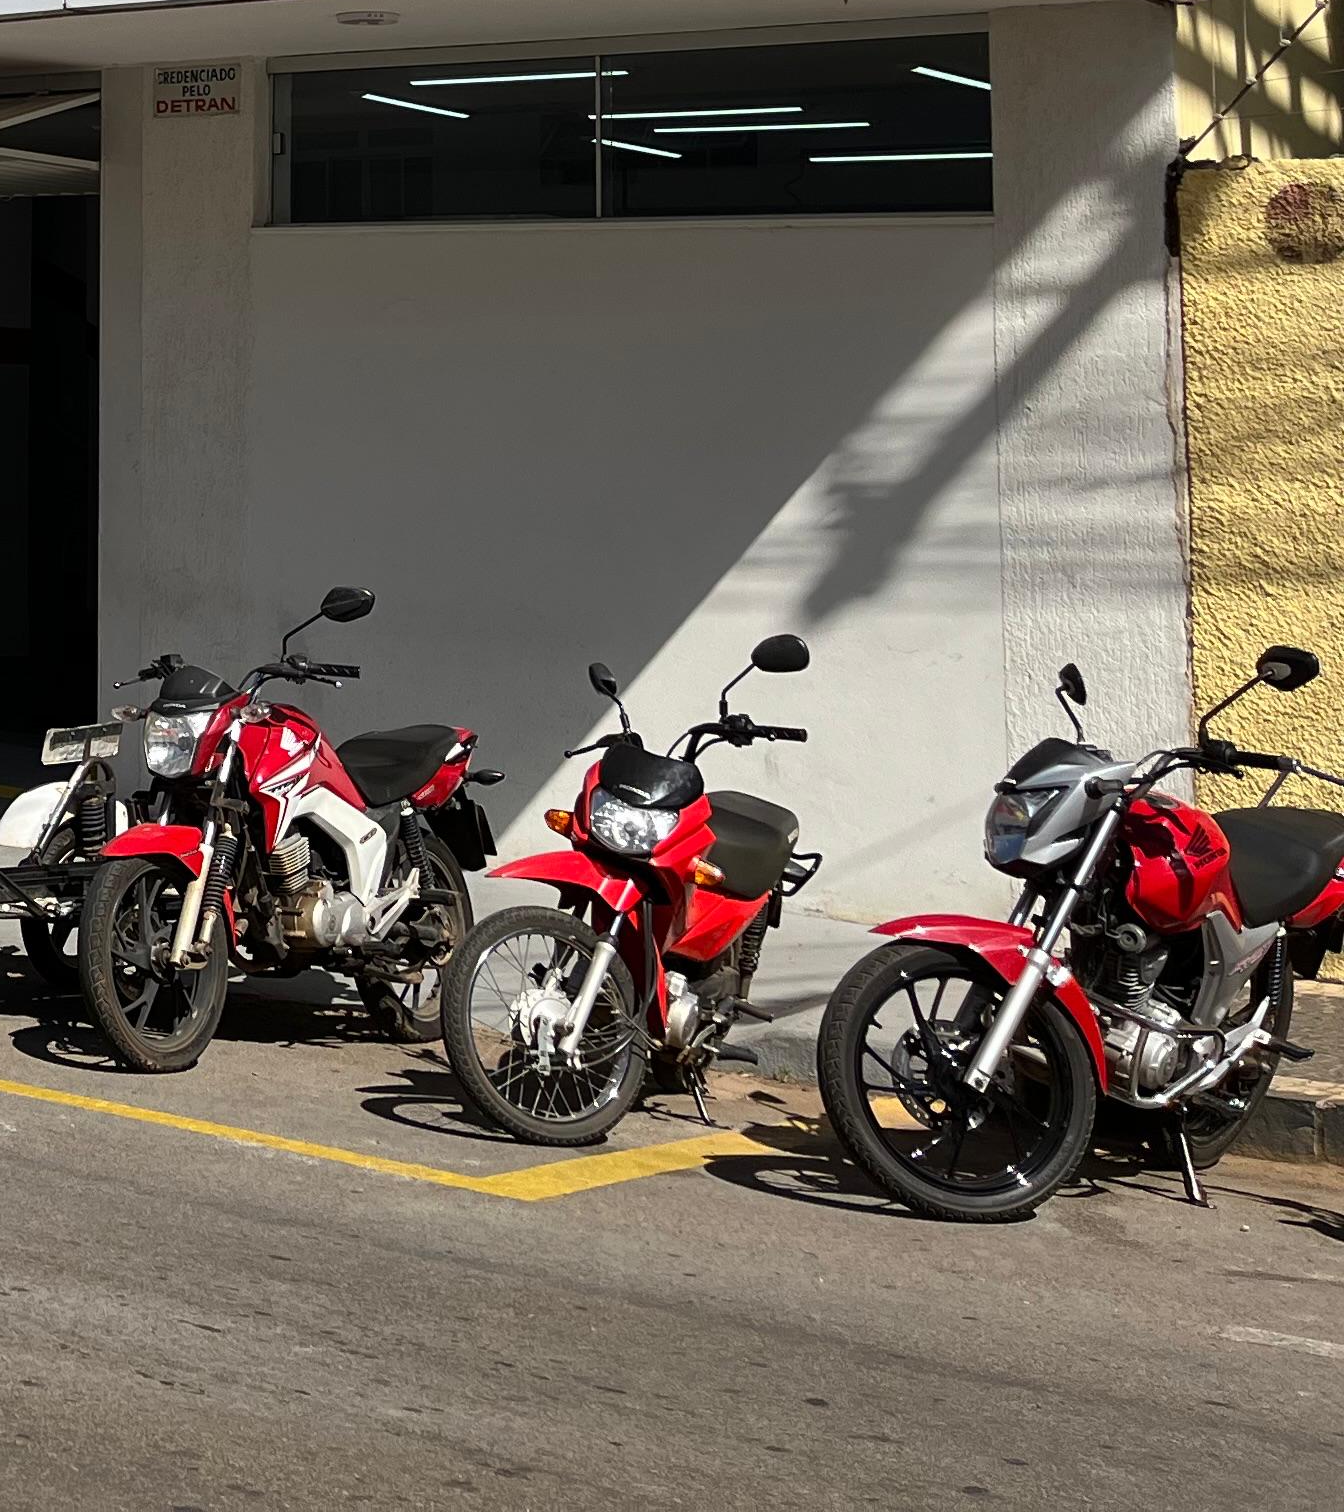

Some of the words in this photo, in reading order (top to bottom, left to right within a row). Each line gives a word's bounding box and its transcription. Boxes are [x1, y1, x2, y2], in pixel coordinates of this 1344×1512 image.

[157, 67, 236, 85] CREDENCIADO
[182, 85, 211, 97] PELO
[156, 97, 236, 114] DETRAN
